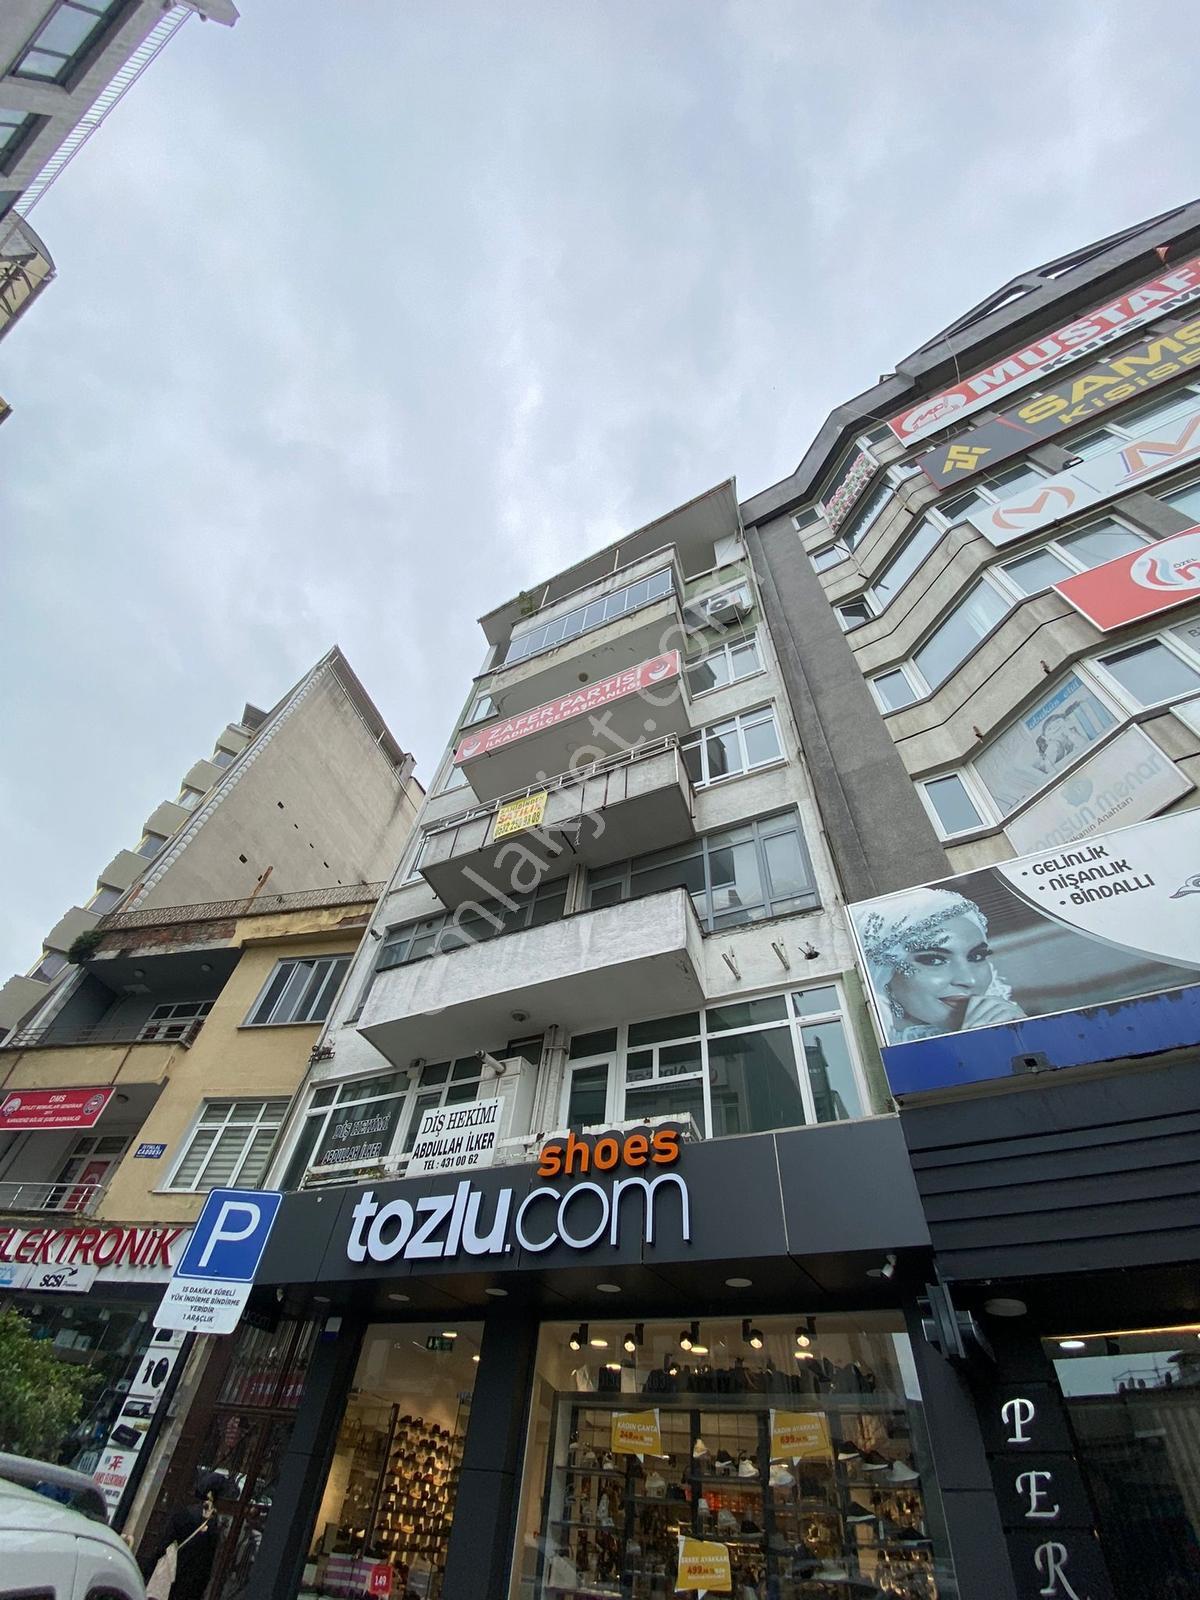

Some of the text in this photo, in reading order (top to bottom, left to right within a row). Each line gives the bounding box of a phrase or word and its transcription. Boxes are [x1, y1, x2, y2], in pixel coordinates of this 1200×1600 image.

[967, 261, 1200, 395] MUSTAF
[488, 667, 643, 739] ZAFER PARTİSİ
[562, 681, 642, 717] BAŞKANLIĞI
[1032, 845, 1110, 876] GELİNLİK
[1049, 859, 1132, 891] NİŞANLIK
[1070, 874, 1155, 906] BİNDALLI
[421, 1100, 499, 1137] DİŞ HEKİMİ
[412, 1131, 496, 1160] ABDULLAH İLKER
[537, 1129, 680, 1177] shoes
[423, 1159, 435, 1171] TEL
[440, 1157, 455, 1168] 431
[455, 1155, 466, 1167] 00
[467, 1153, 479, 1165] 62
[346, 1172, 690, 1262] tozlu.com
[198, 1200, 261, 1267] P
[39, 1274, 65, 1288] SCSI
[189, 1286, 213, 1295] DAKİKA
[213, 1288, 237, 1297] SÜRELİ
[170, 1294, 241, 1306] YÜK İNDİRME BİNDİRME
[190, 1305, 215, 1313] YERİDİR
[186, 1314, 214, 1323] ARAÇLIK
